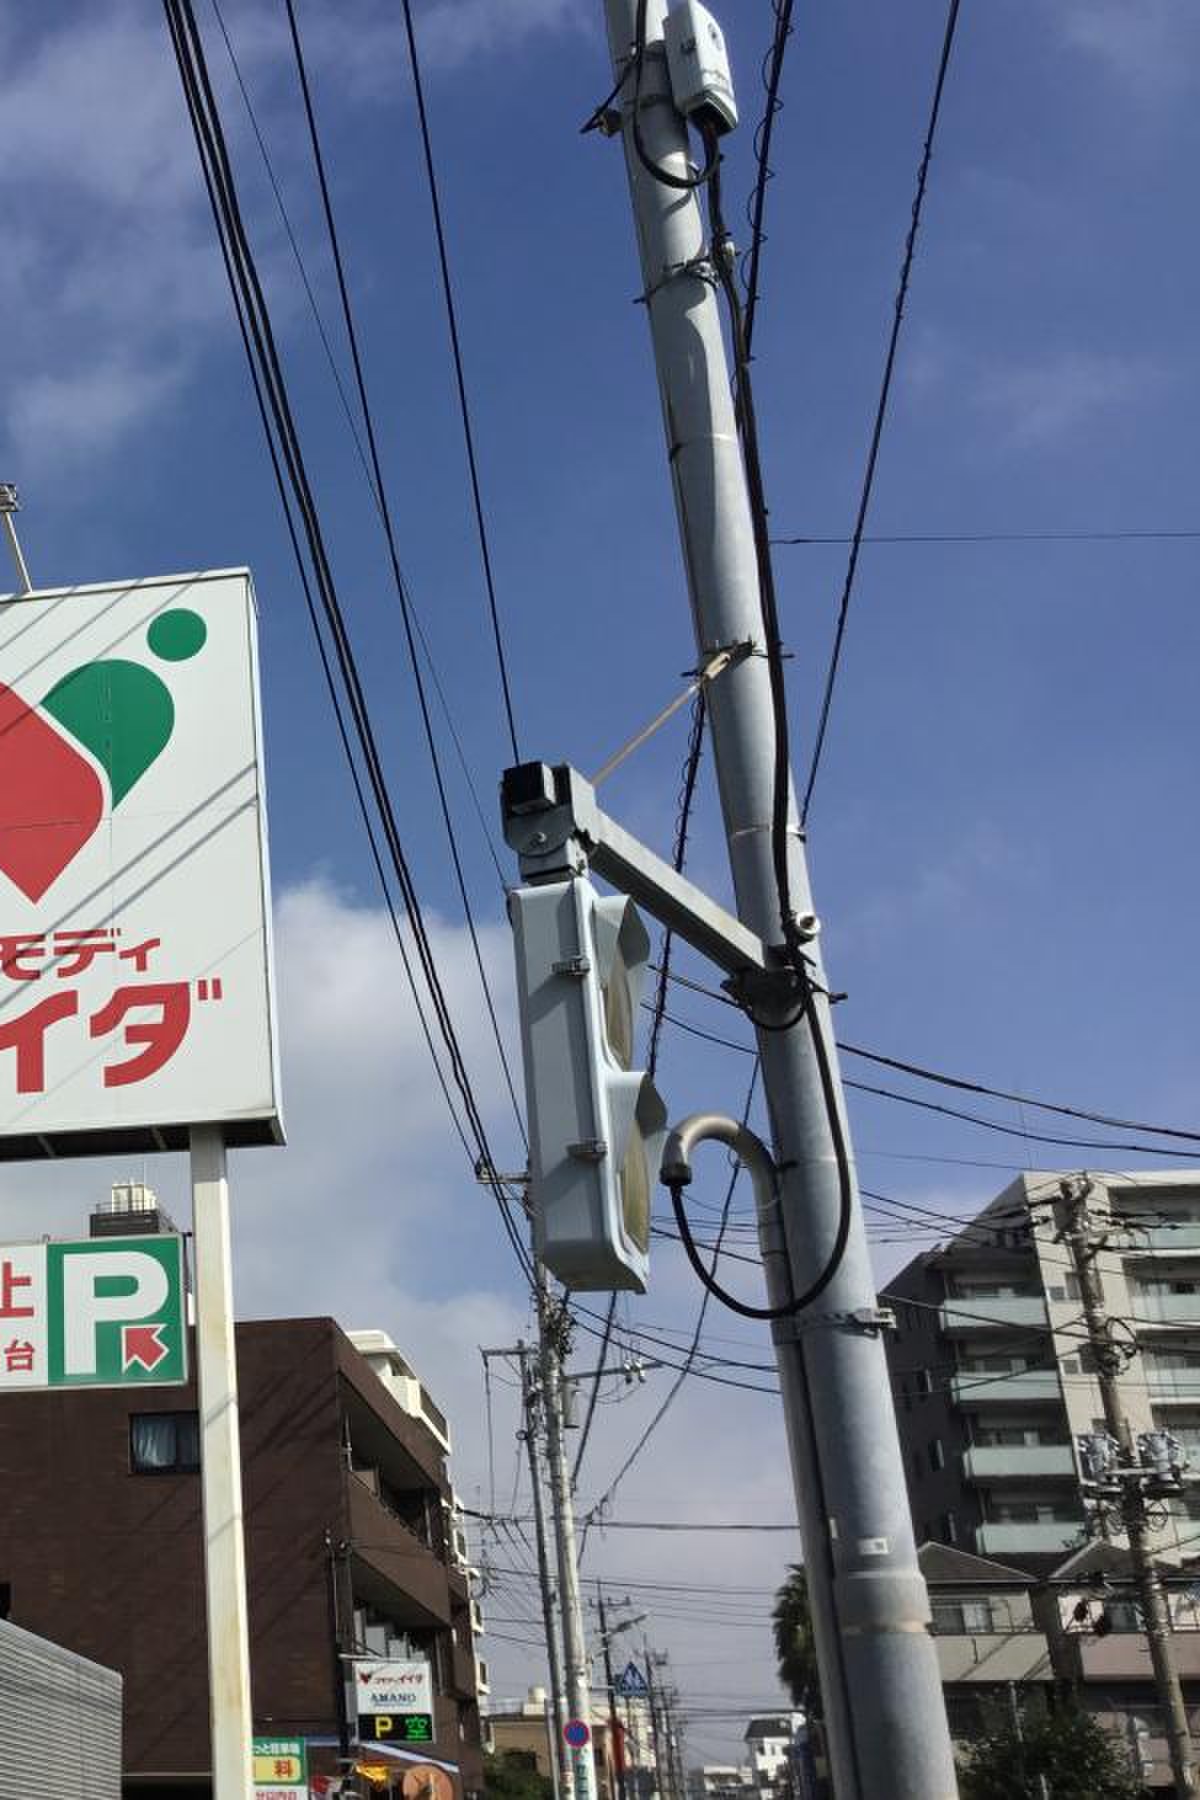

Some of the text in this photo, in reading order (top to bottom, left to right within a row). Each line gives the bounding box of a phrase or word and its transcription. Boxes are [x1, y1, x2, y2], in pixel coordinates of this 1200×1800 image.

[63, 1251, 169, 1376] P
[371, 1693, 416, 1702] AMANO
[375, 1716, 393, 1739] P
